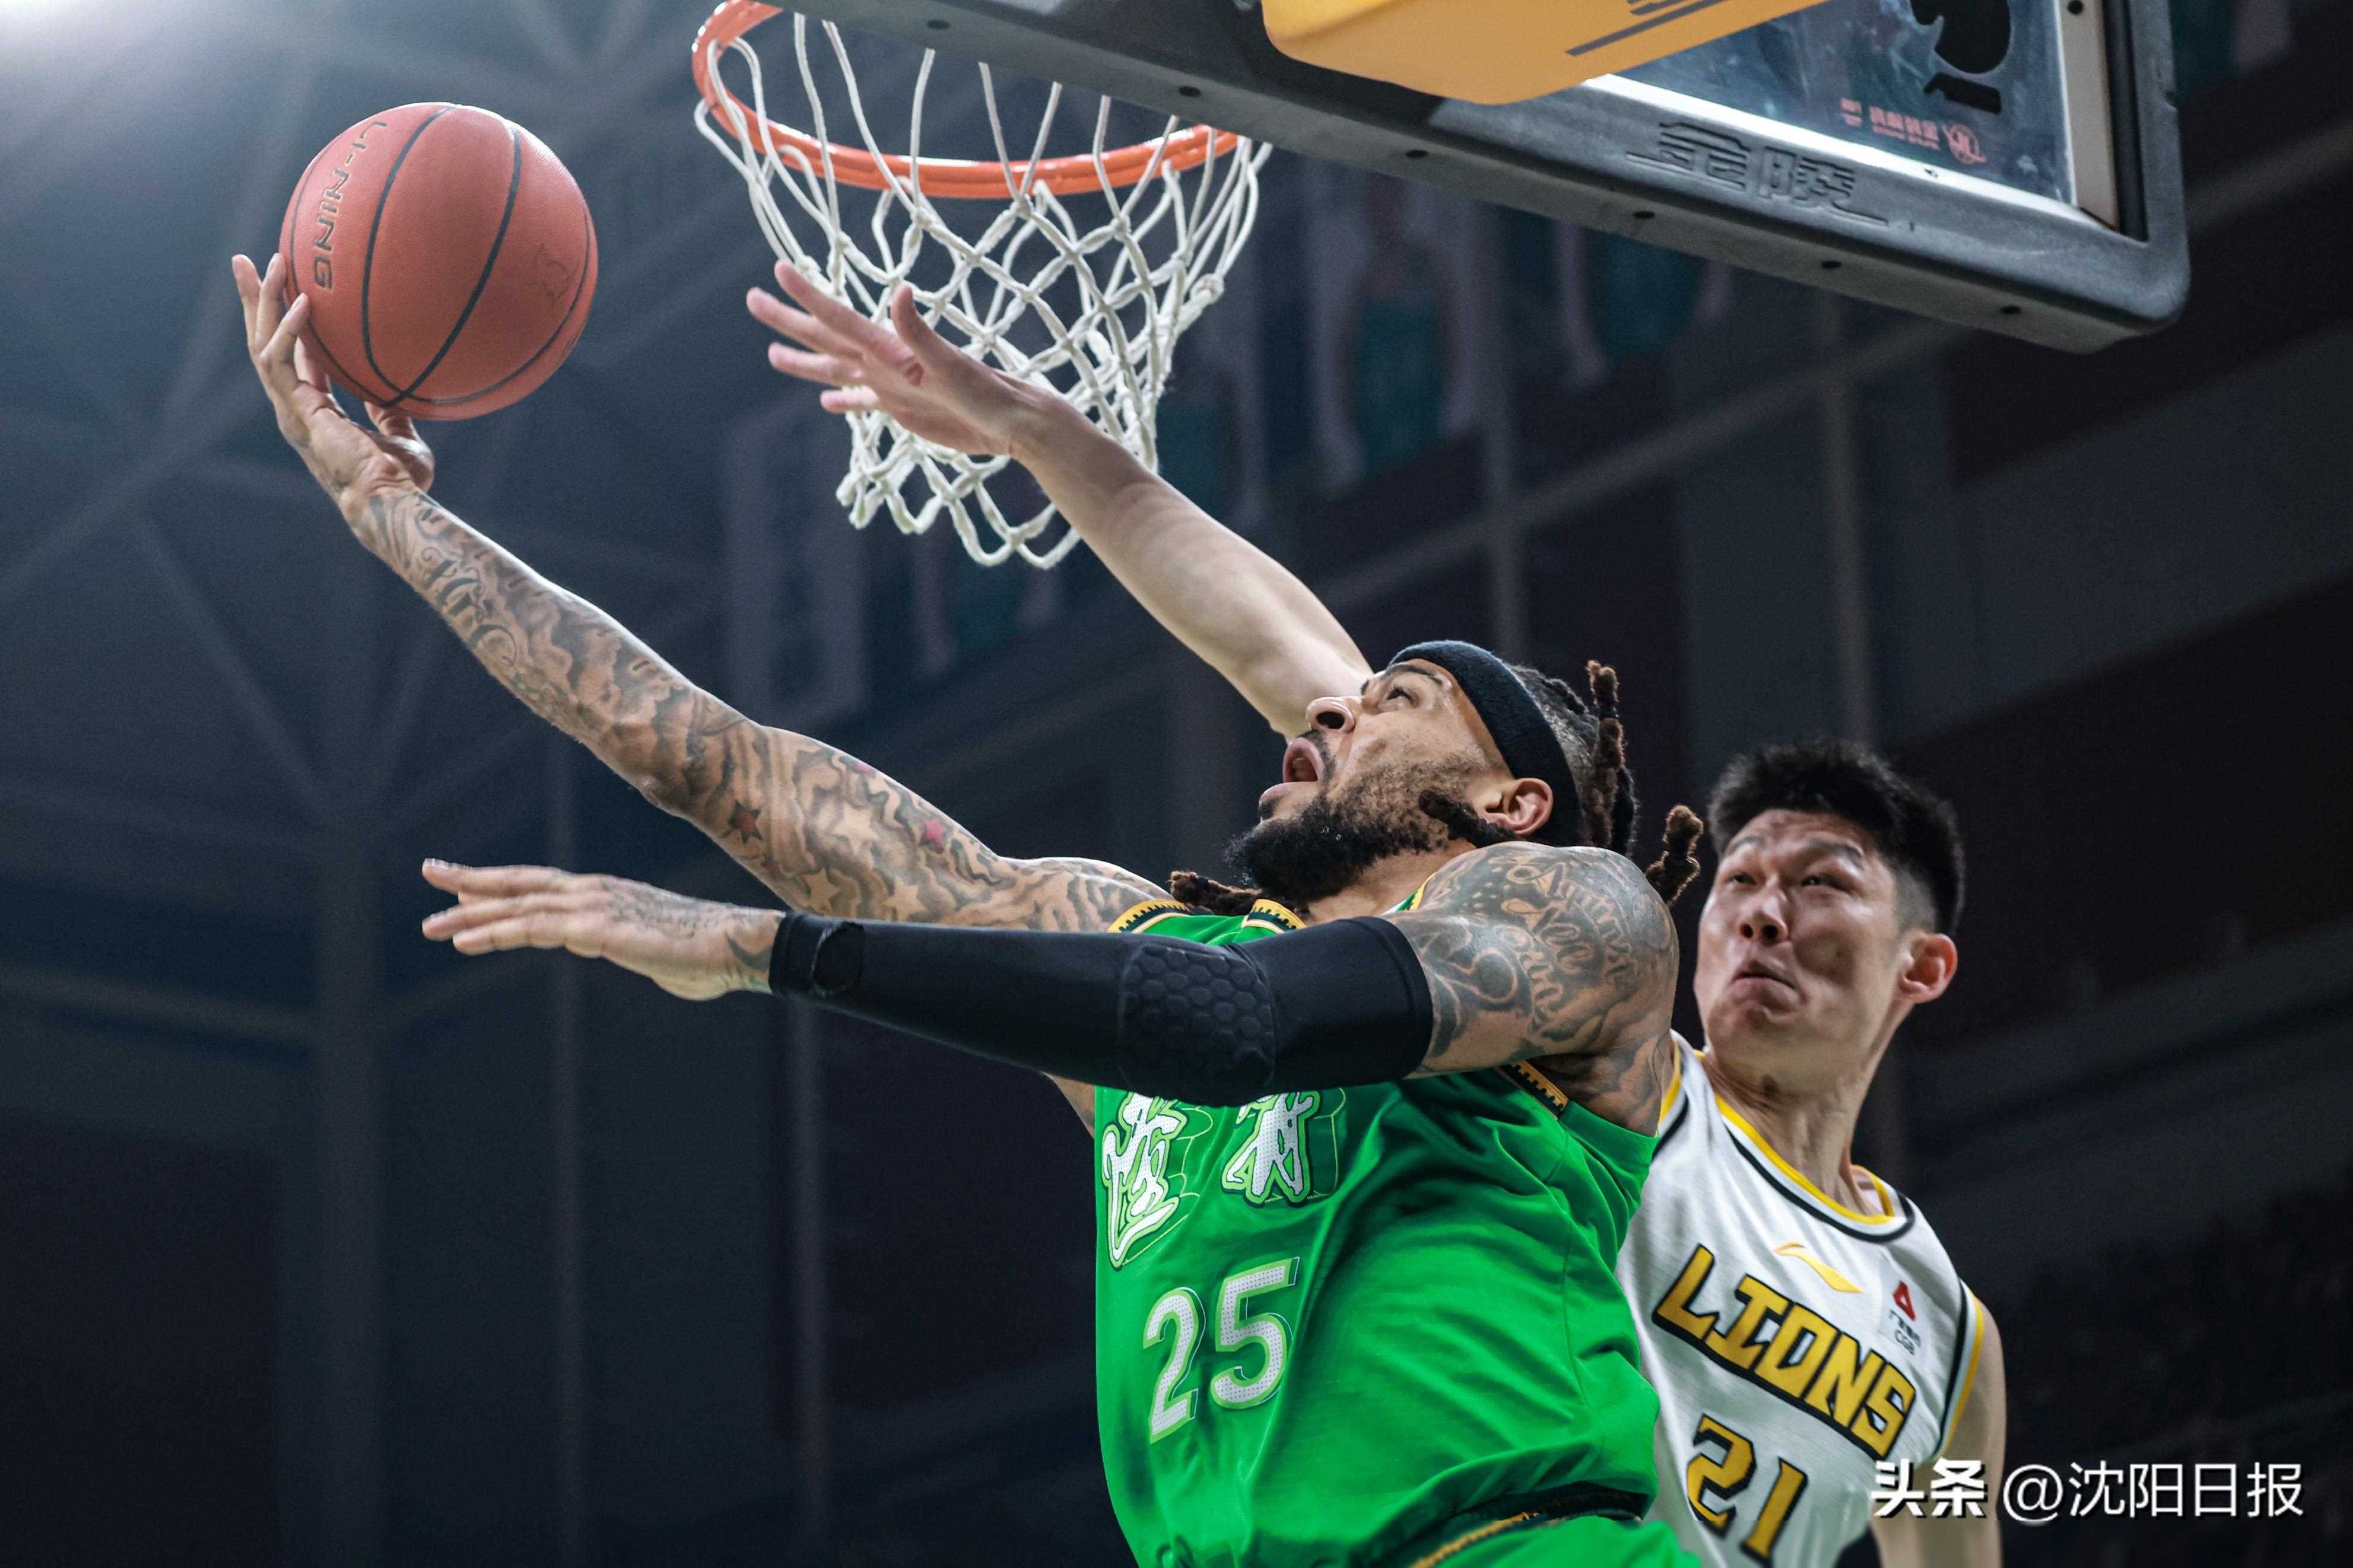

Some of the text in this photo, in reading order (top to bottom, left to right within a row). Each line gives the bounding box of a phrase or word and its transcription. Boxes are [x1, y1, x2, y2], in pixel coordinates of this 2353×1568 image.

[312, 120, 388, 291] LI-NING
[1142, 1257, 1300, 1444] 25
[1652, 1243, 1917, 1463] LIONS
[1685, 1413, 1809, 1567] 21
